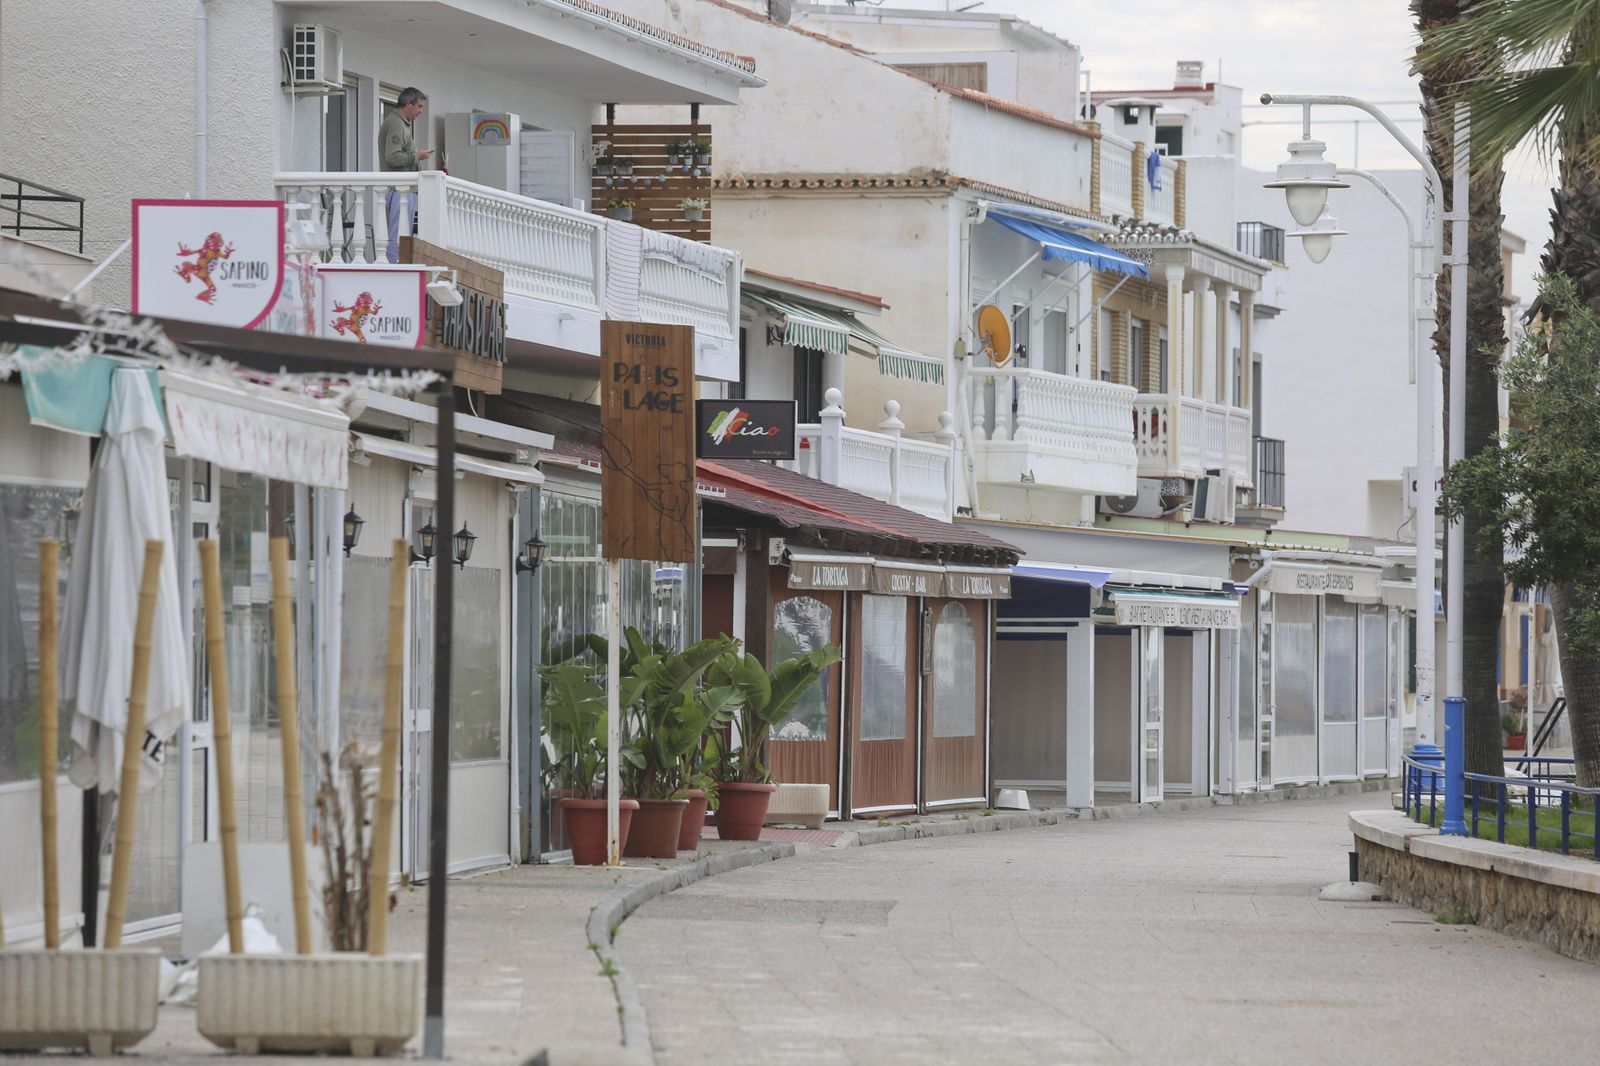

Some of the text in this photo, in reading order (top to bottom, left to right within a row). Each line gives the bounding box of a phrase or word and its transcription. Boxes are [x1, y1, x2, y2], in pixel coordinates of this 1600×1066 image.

[220, 261, 269, 281] SAPINO
[369, 316, 412, 334] SAPINO
[625, 332, 666, 347] VICTORIA
[728, 417, 781, 437] Ciao
[812, 565, 821, 586] LA
